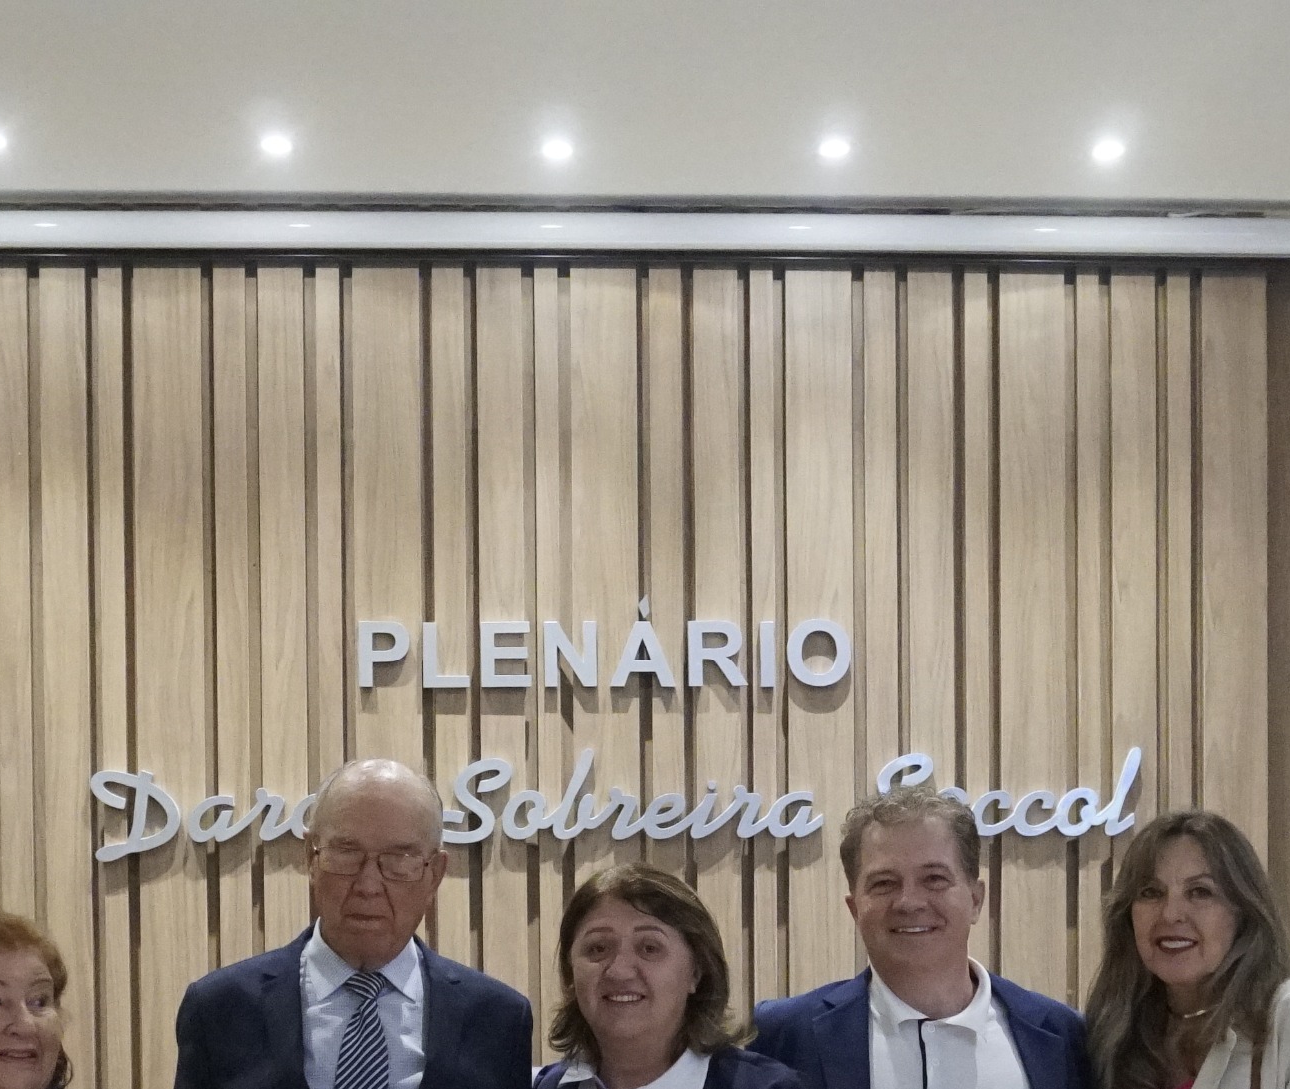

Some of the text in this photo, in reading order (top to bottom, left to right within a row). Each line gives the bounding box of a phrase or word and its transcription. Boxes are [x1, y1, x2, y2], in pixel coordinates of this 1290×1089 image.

[358, 595, 852, 689] PLENÁRIO
[89, 769, 317, 863] Dar
[442, 748, 824, 844] Sobreira
